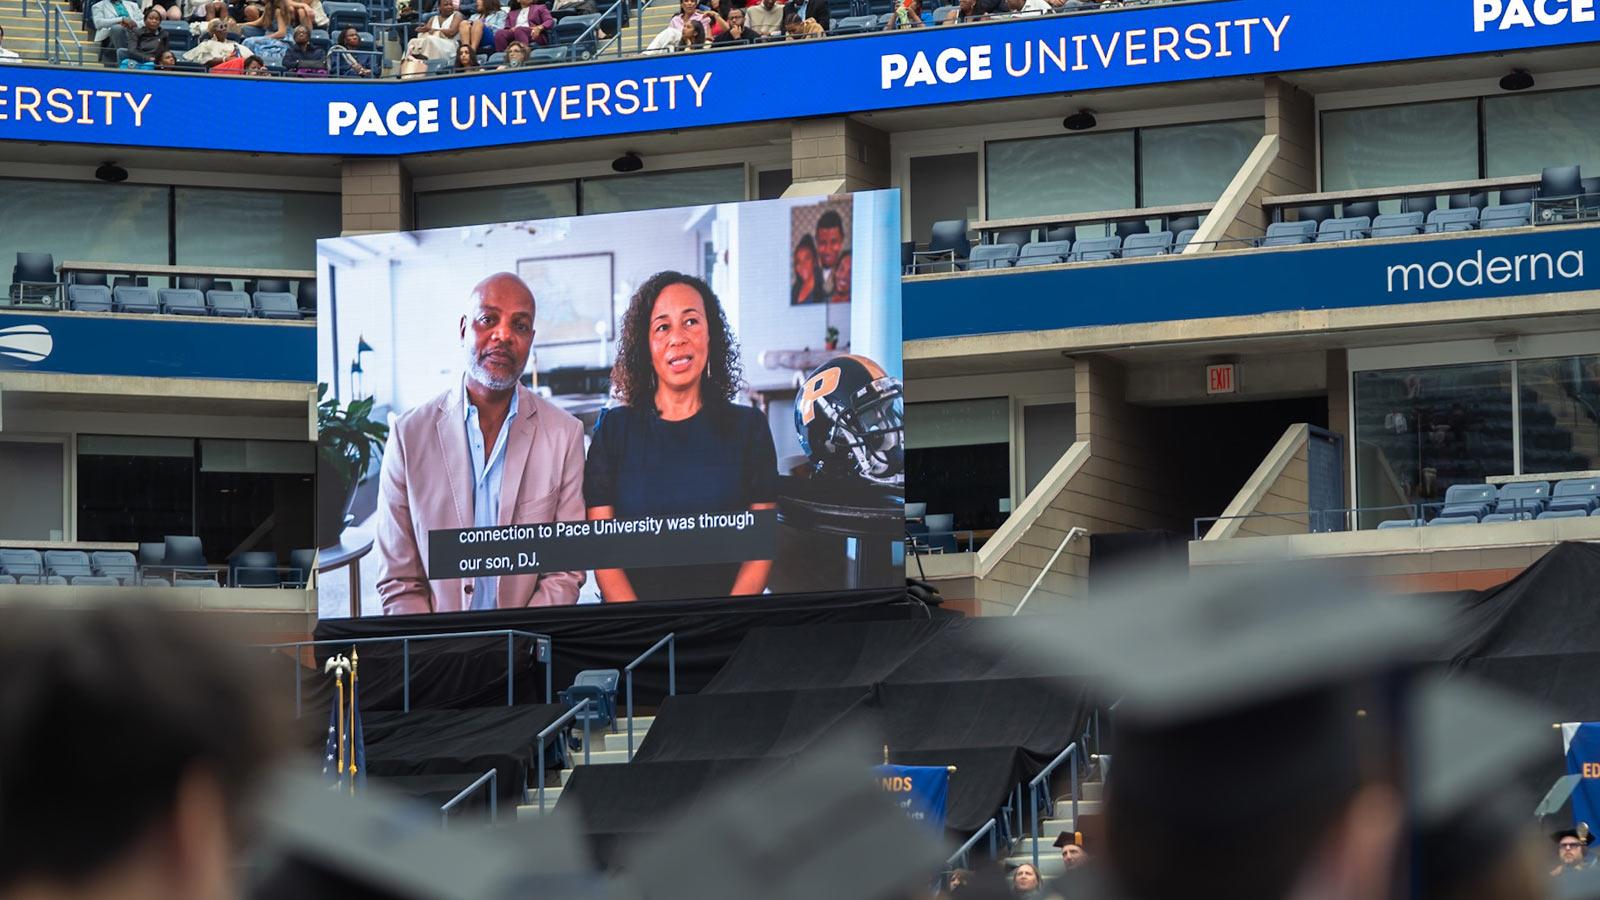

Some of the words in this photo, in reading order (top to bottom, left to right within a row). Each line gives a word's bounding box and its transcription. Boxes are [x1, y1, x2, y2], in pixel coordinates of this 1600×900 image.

[1473, 0, 1595, 32] PACE
[881, 44, 993, 89] PACE
[1005, 15, 1291, 77] UNIVERSITY
[328, 99, 439, 136] PACE
[450, 72, 713, 131] UNIVERSITY
[1387, 249, 1584, 292] moderna
[1210, 367, 1231, 391] EXIT
[459, 526, 535, 543] connection
[538, 524, 552, 538] to
[556, 522, 590, 537] Pace
[594, 516, 663, 535] University
[667, 518, 696, 531] was
[699, 511, 755, 528] through
[459, 558, 482, 570] our
[485, 556, 514, 570] son,
[518, 552, 540, 567] DJ.
